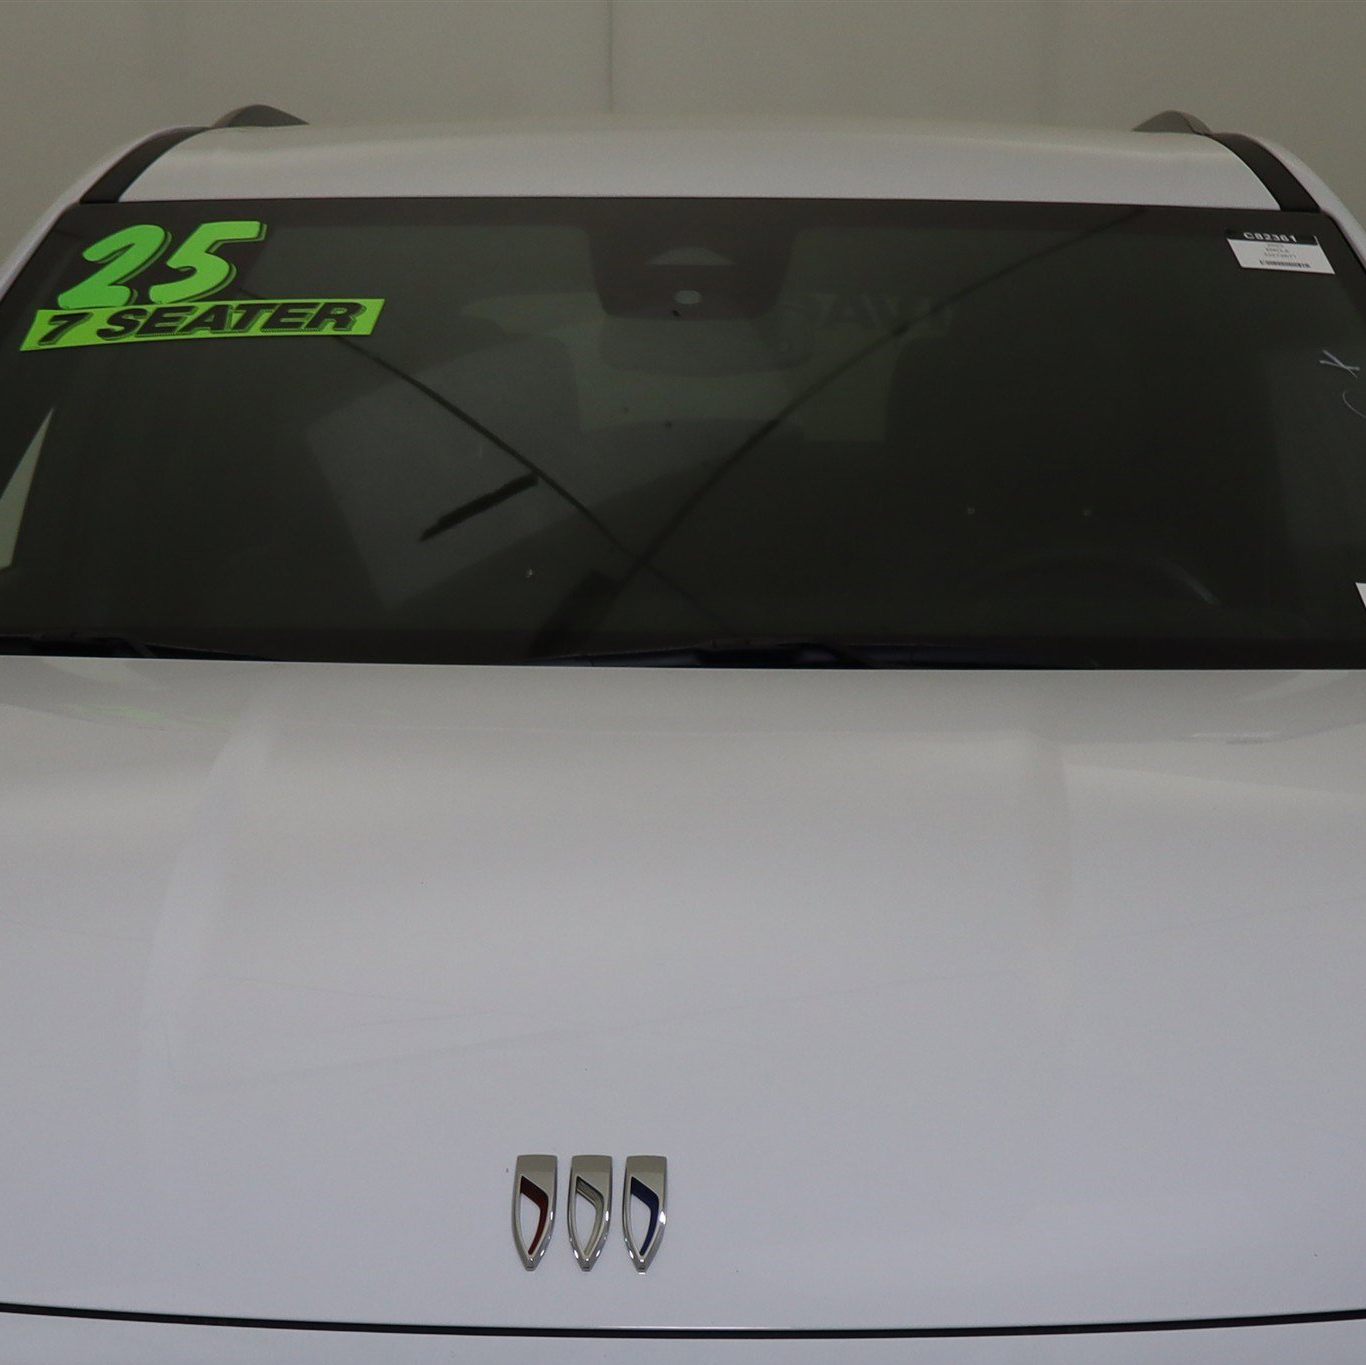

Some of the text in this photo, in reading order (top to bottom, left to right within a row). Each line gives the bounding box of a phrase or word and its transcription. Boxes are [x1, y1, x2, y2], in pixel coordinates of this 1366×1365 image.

[57, 220, 267, 309] 25
[38, 302, 367, 346] 7 SEATER
